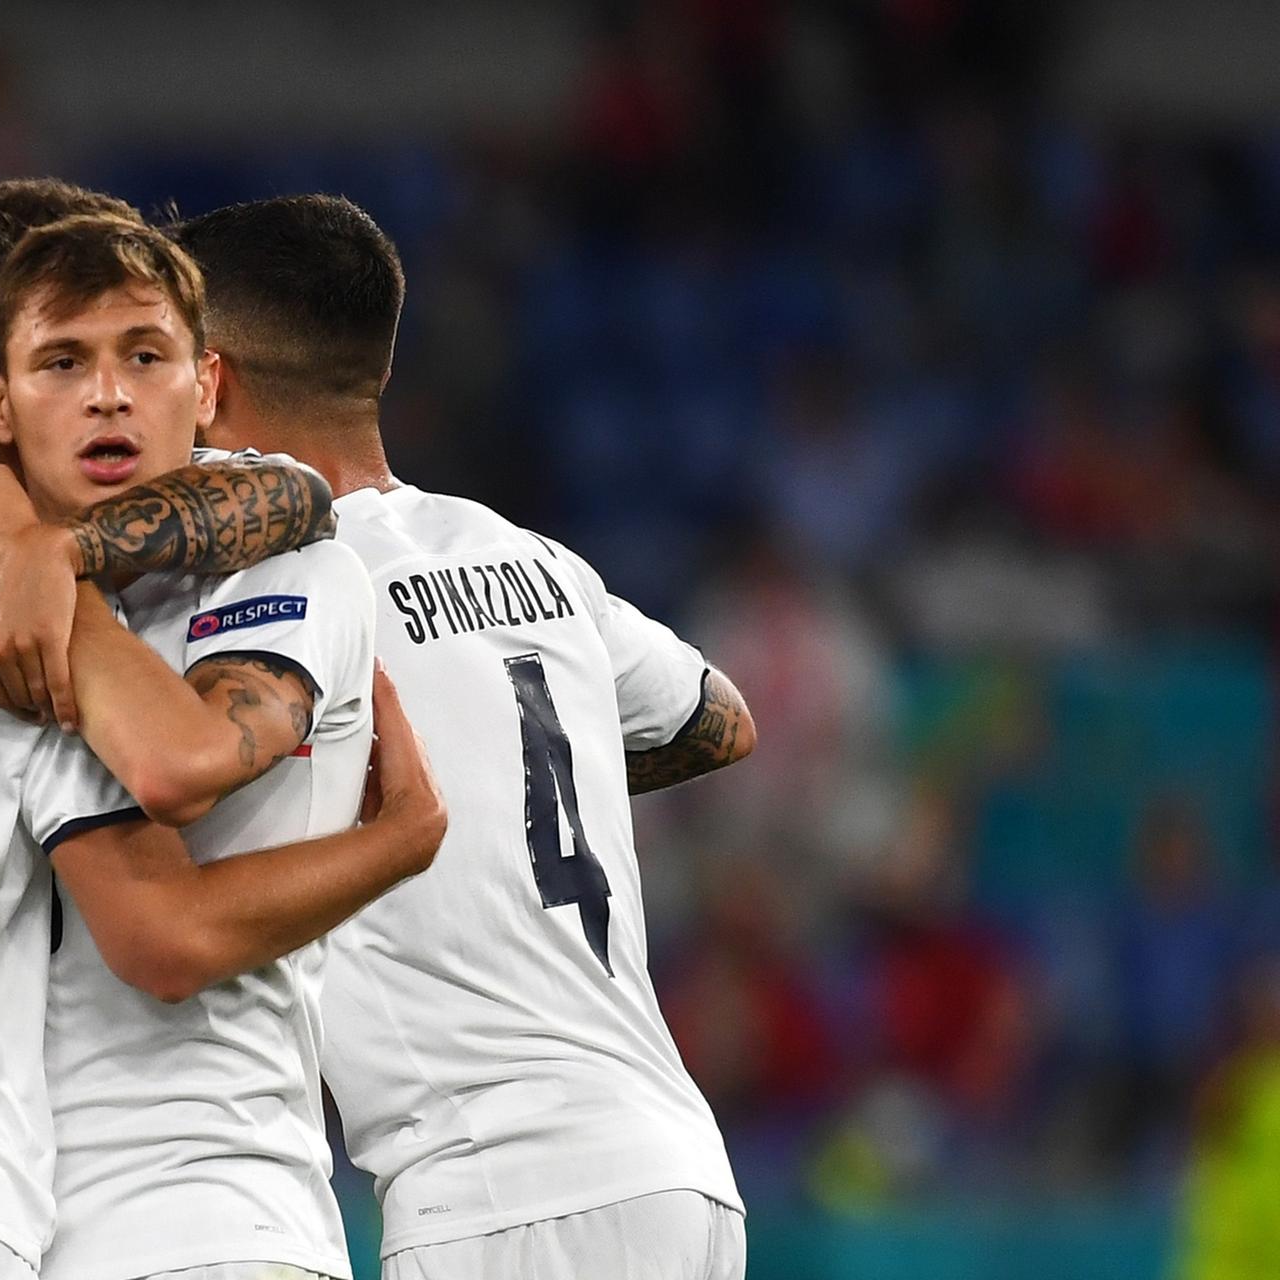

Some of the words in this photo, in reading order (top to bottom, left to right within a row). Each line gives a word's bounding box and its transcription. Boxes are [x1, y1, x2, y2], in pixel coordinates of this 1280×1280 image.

[222, 600, 306, 627] RESPECT
[388, 558, 576, 645] SPINAZZOLA
[508, 649, 617, 978] 4
